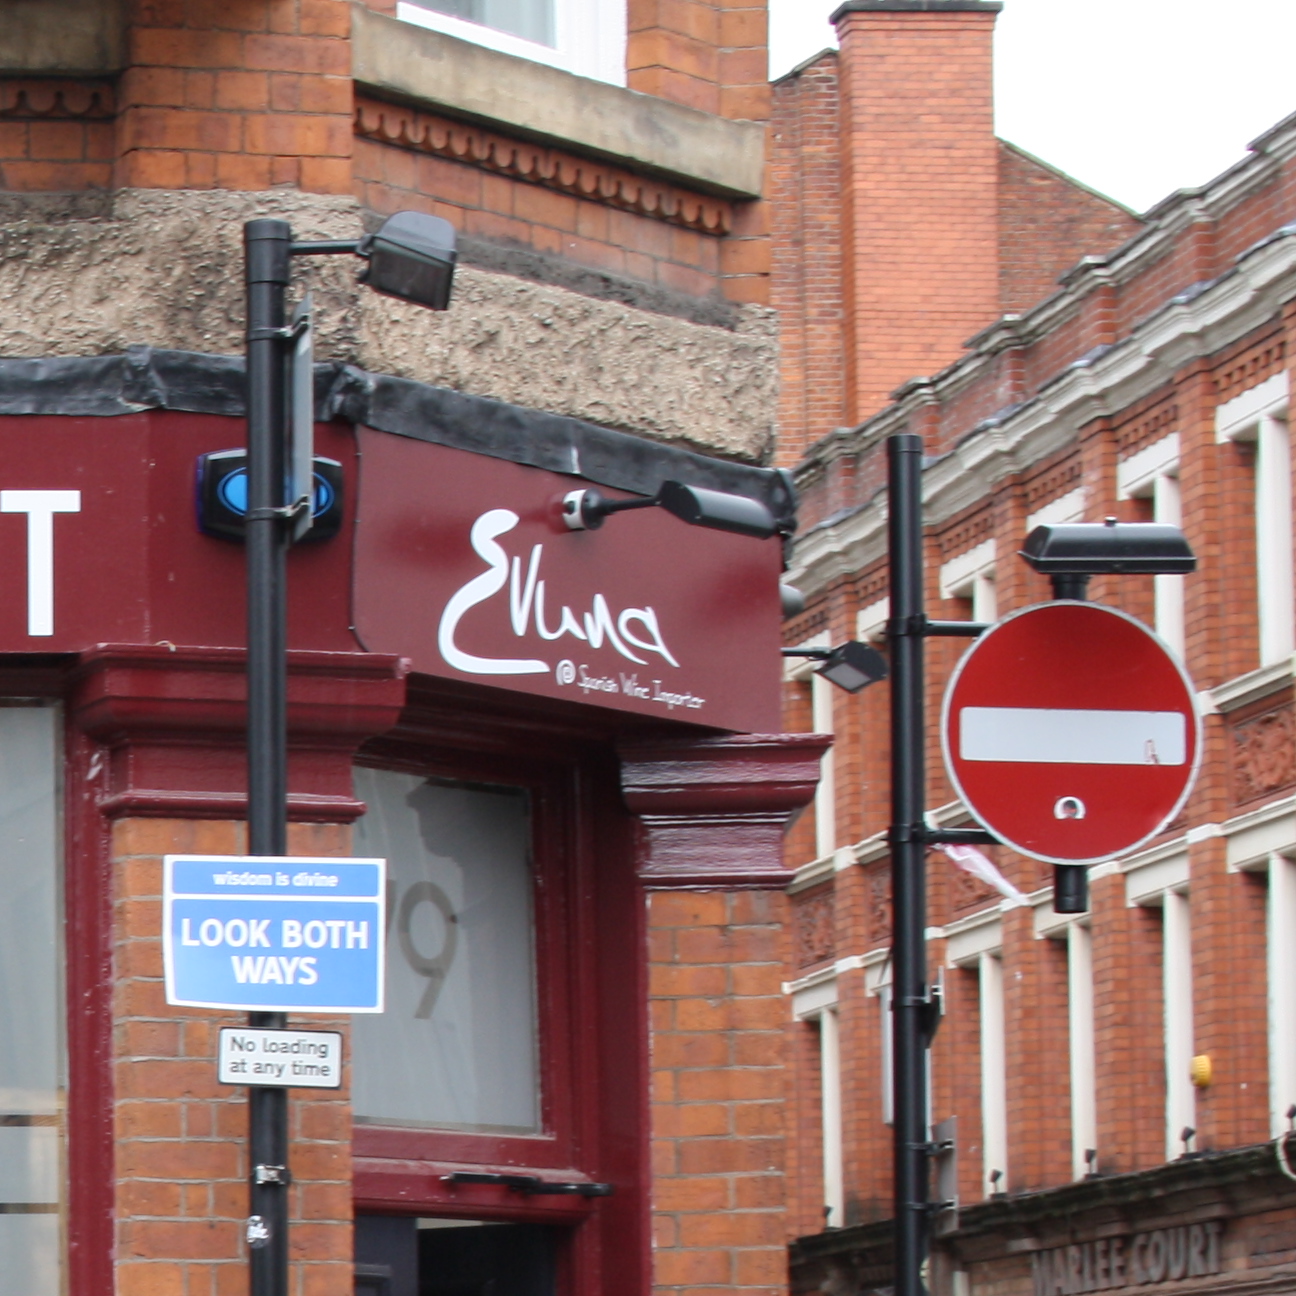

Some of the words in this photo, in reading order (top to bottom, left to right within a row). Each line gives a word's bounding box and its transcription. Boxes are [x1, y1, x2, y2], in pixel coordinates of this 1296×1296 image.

[438, 509, 680, 674] Evuna
[213, 871, 272, 886] wisdom
[276, 872, 289, 886] is
[293, 872, 339, 887] divine
[181, 918, 271, 947] LOOK
[282, 920, 369, 949] BOTH
[231, 956, 318, 985] WAYS
[230, 1036, 256, 1052] No
[263, 1037, 329, 1058] loading
[230, 1060, 247, 1073] at
[253, 1063, 286, 1078] any
[292, 1060, 331, 1077] time
[1132, 1221, 1223, 1285] COURT
